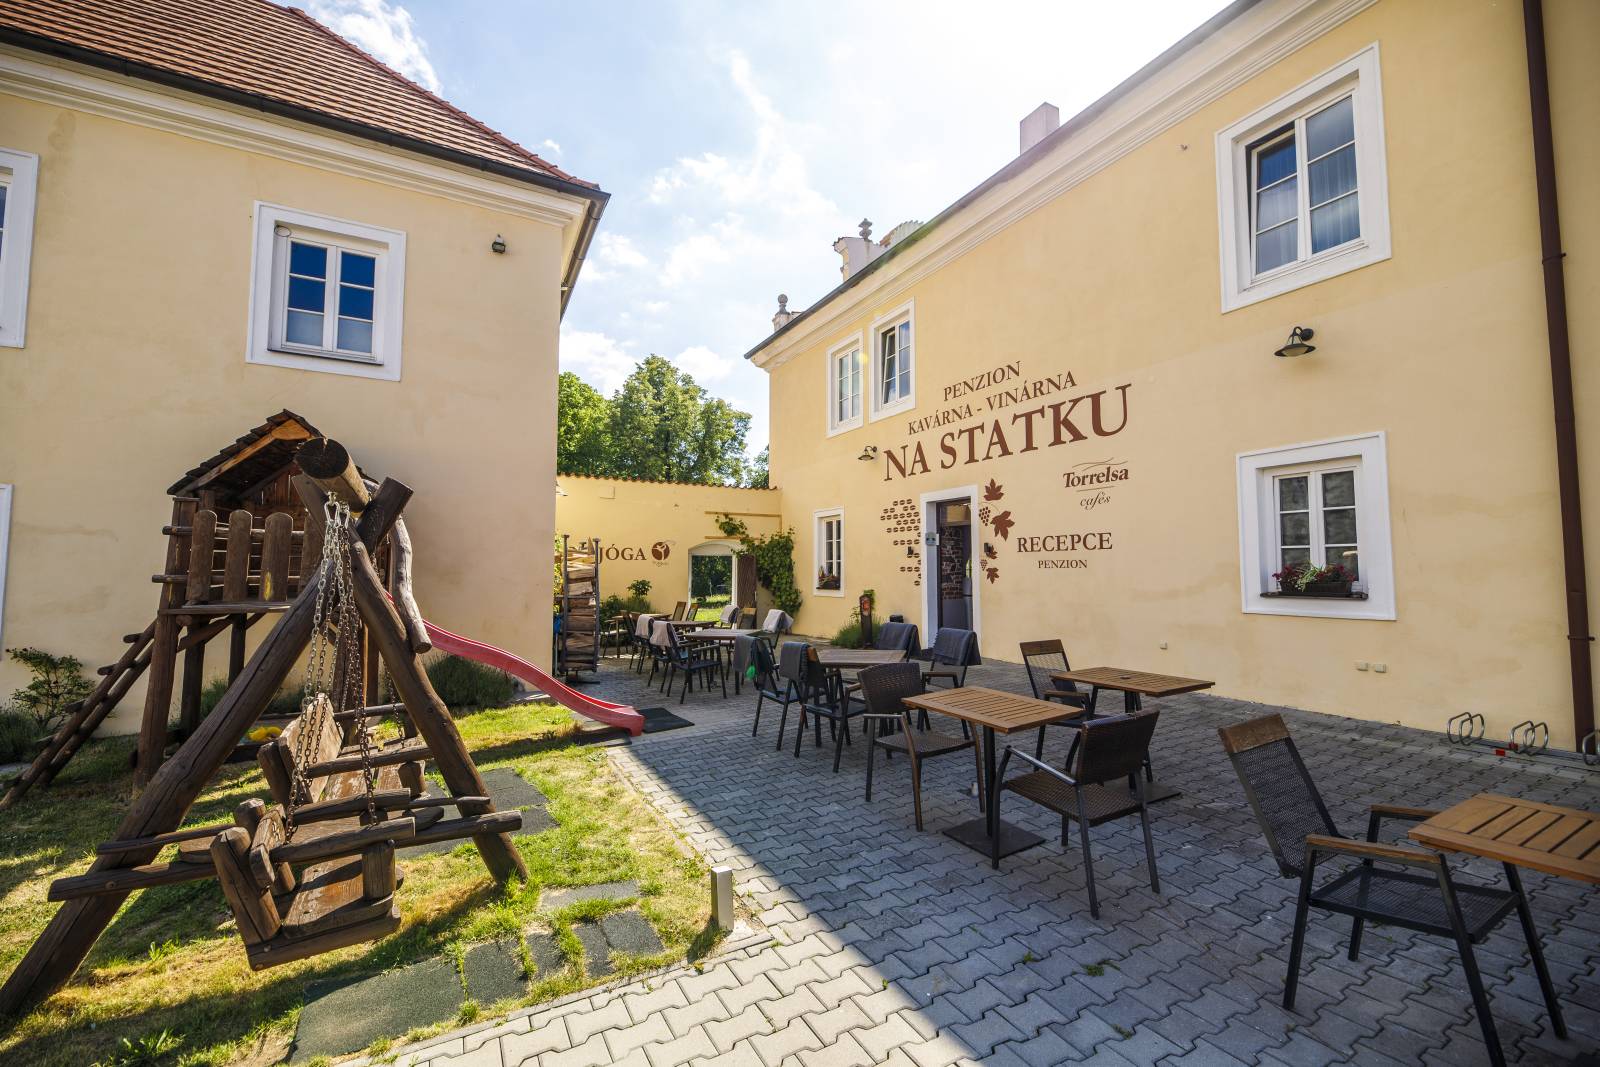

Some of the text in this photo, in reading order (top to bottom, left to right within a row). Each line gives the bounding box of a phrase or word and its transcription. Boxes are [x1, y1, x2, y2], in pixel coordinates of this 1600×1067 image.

[944, 361, 1020, 401] PENZION
[908, 404, 973, 435] KAVÁRNA
[986, 371, 1077, 411] VINÁRNA
[883, 384, 1131, 481] NA STATKU
[1062, 466, 1129, 488] Torrelsa
[1017, 532, 1113, 553] RECEPCE
[599, 544, 647, 564] JÓGA
[1038, 560, 1088, 569] PENZION
